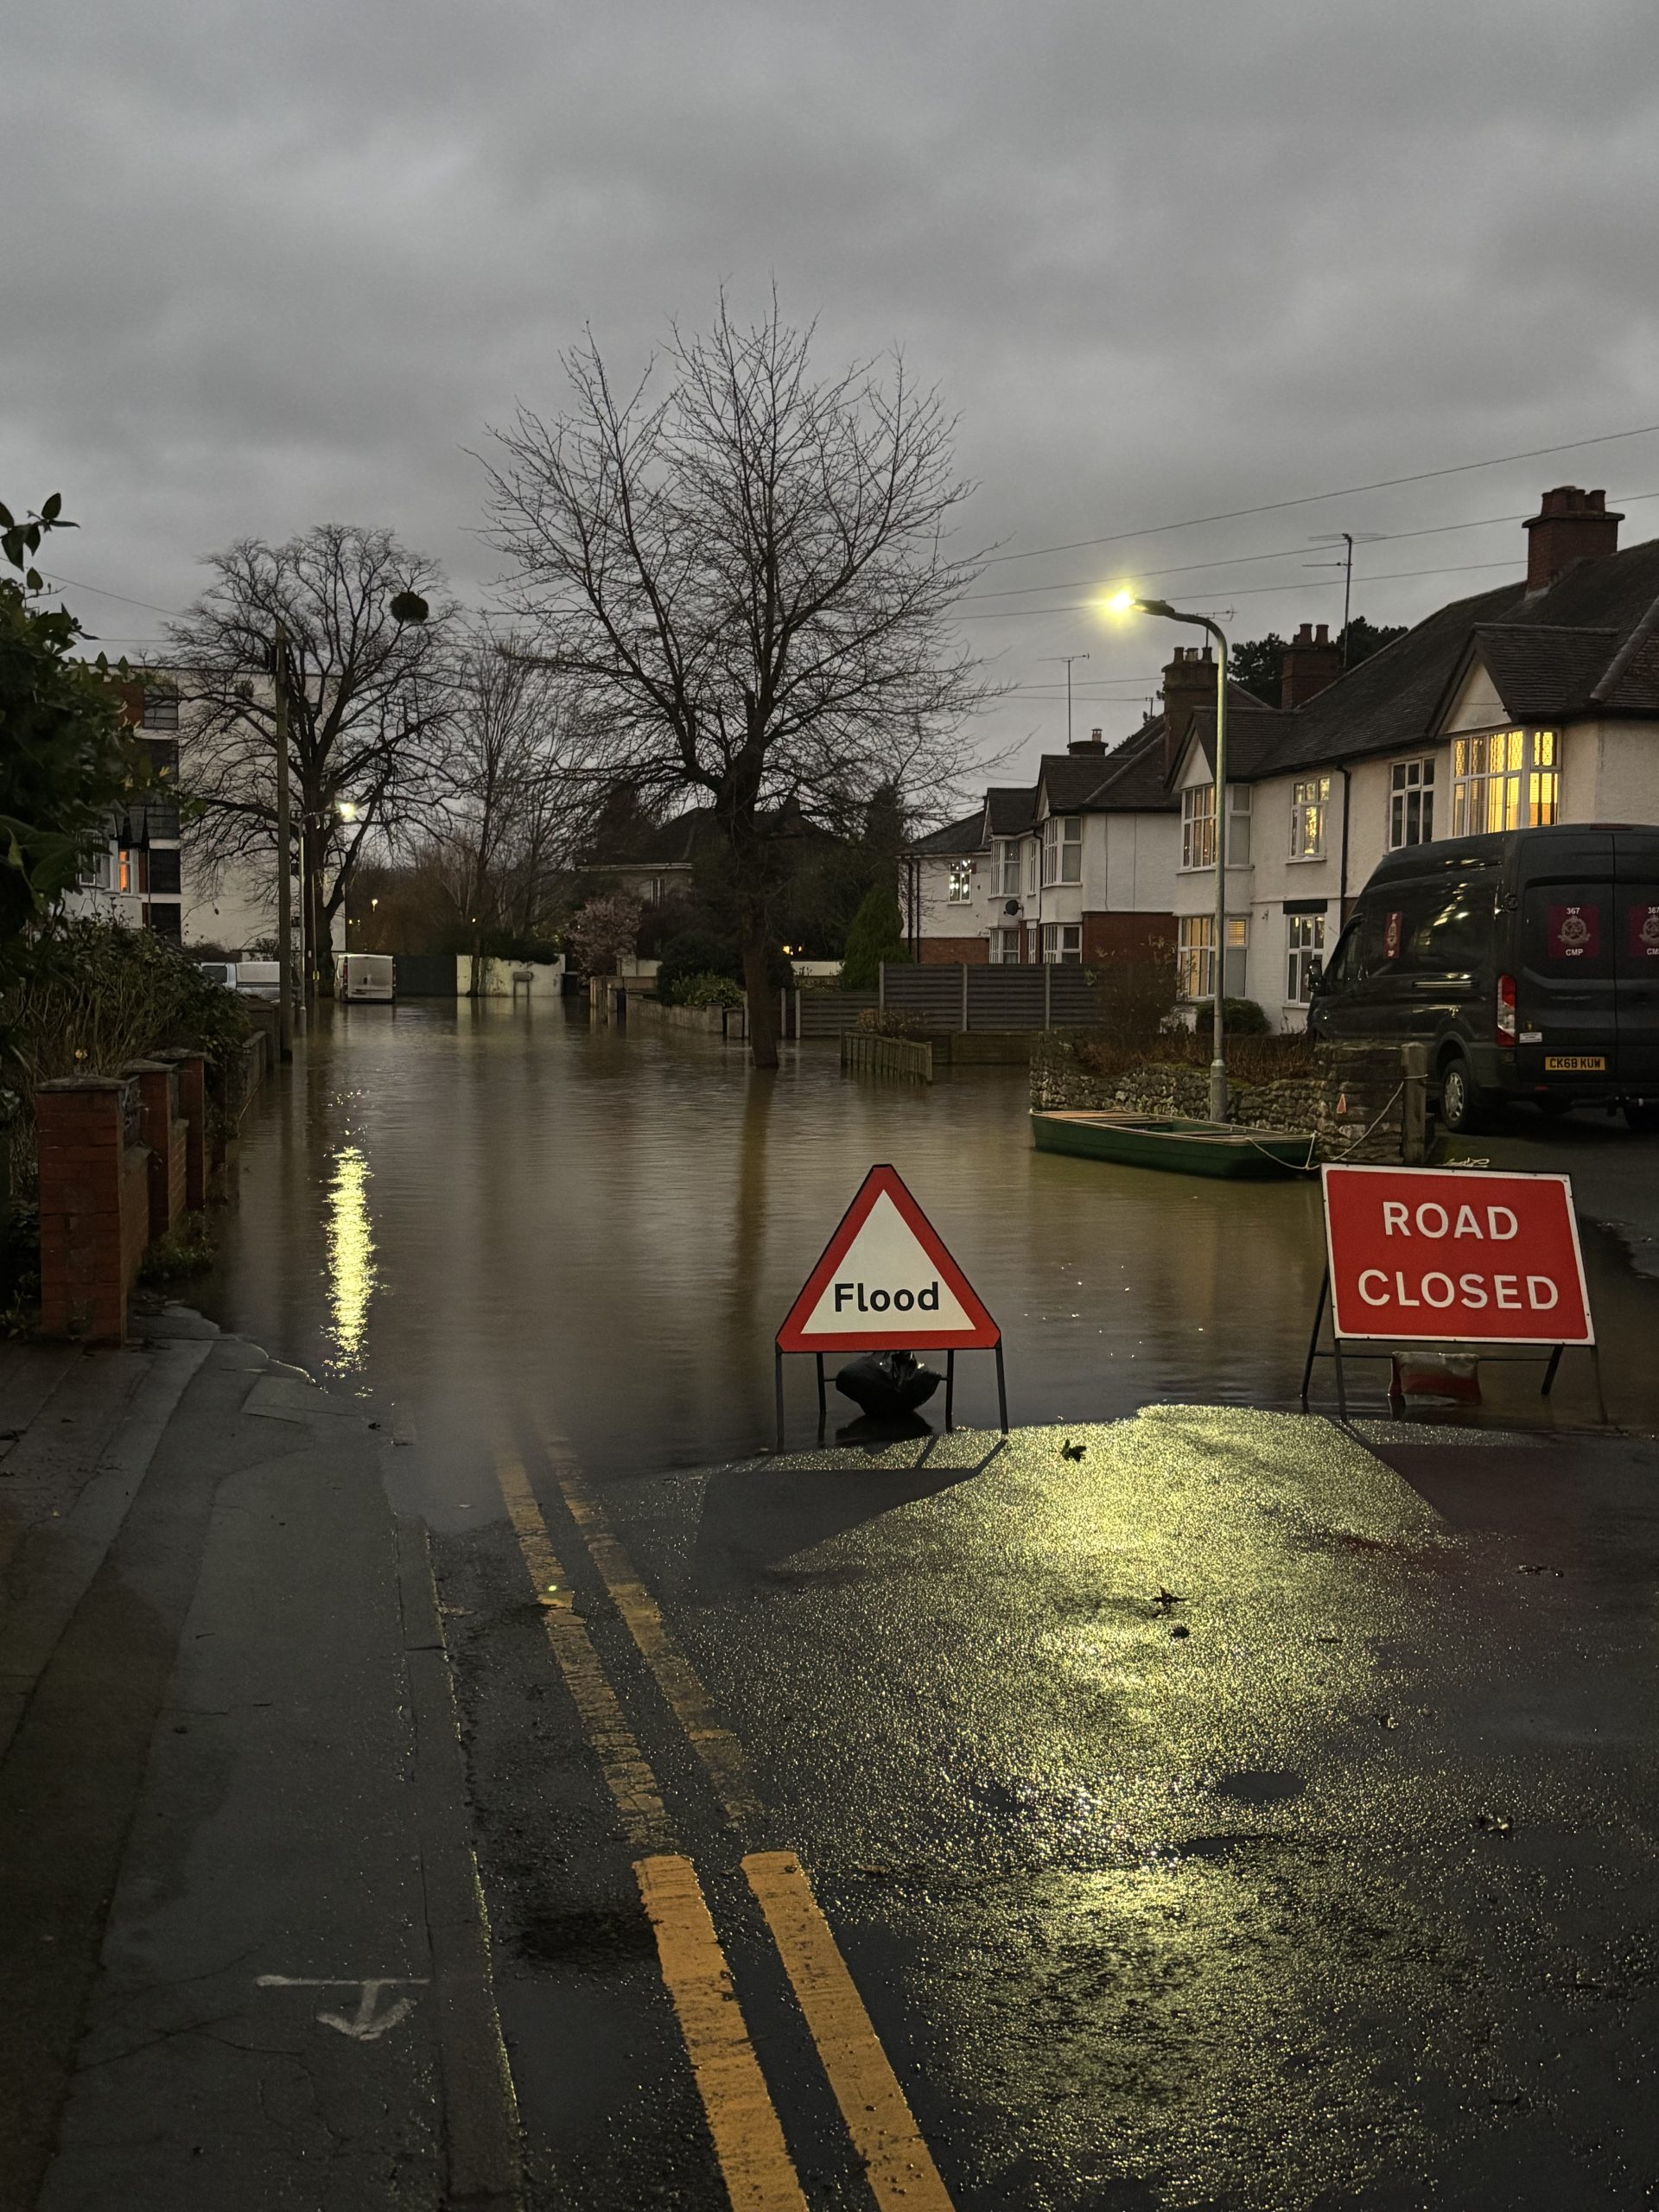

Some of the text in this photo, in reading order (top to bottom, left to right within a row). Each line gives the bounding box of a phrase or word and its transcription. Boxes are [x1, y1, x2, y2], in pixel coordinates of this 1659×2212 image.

[1549, 1058, 1601, 1069] CK68 KUW
[1382, 1201, 1518, 1240] ROAD
[834, 1281, 939, 1313] Flood
[1357, 1268, 1559, 1310] CLOSED
